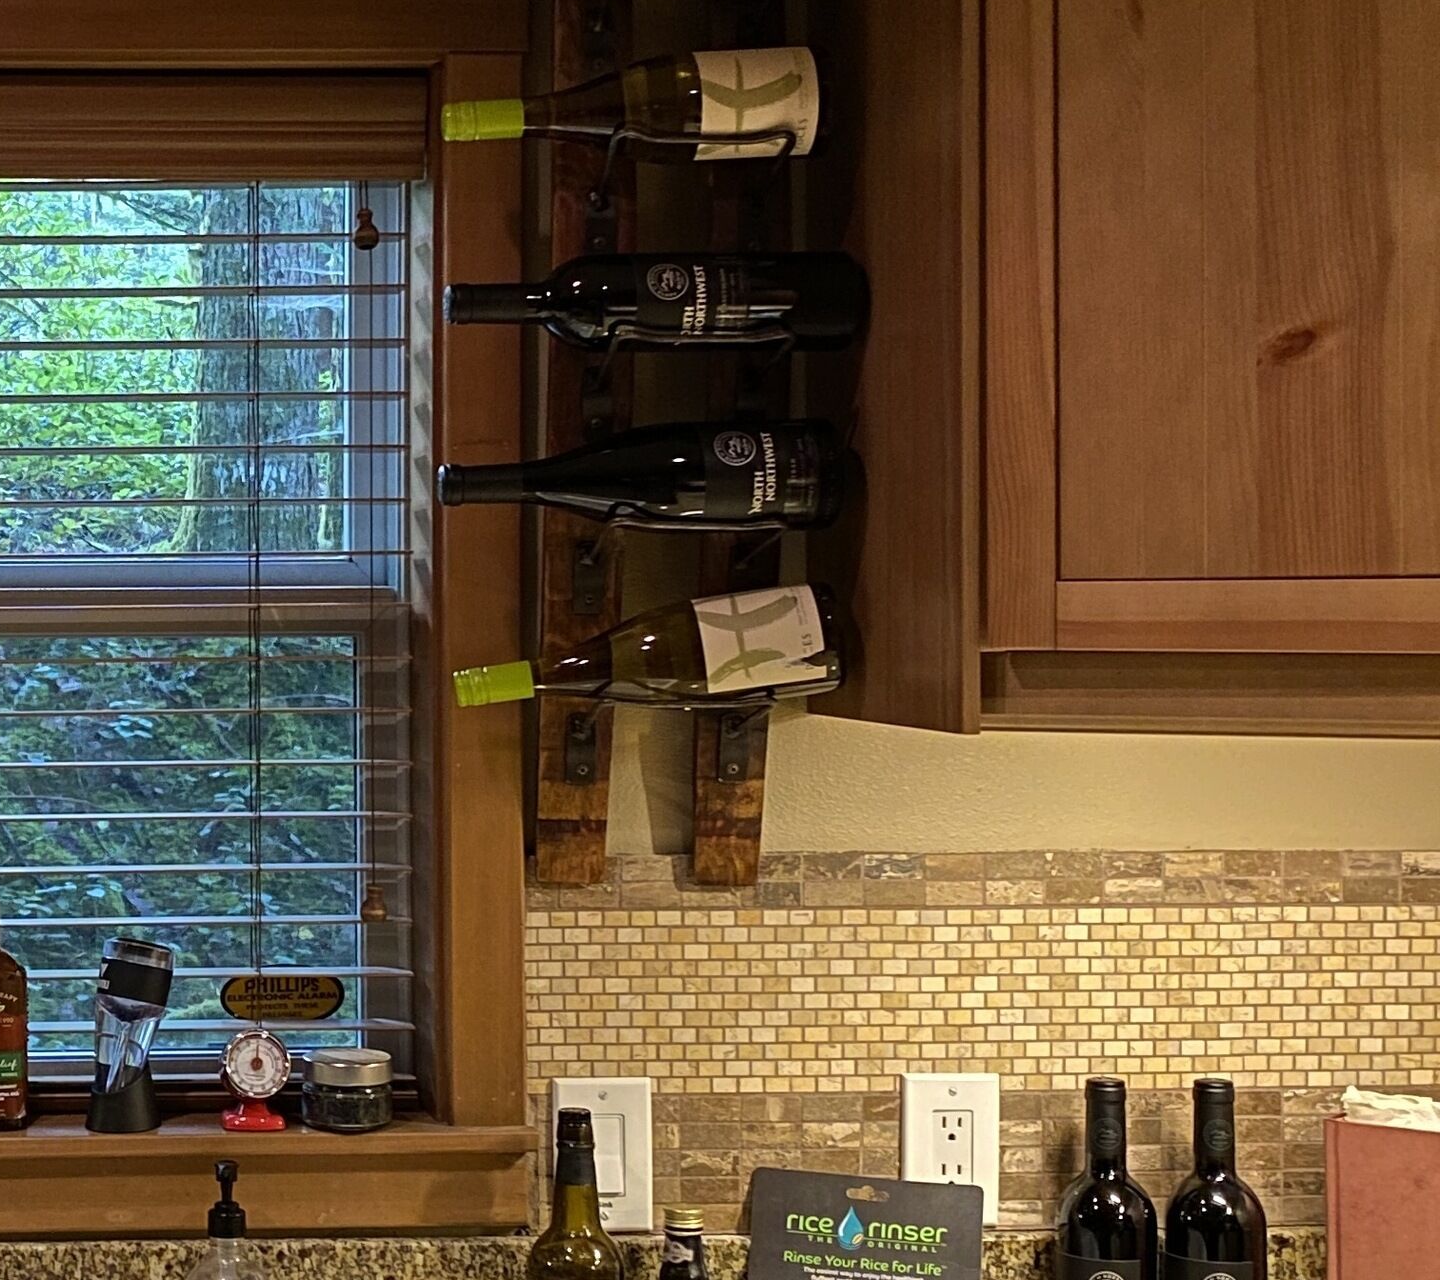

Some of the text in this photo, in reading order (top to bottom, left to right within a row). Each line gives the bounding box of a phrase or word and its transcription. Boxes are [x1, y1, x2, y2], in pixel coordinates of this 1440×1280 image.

[759, 431, 777, 502] NORTHWEST
[747, 470, 765, 516] NORTH
[245, 976, 320, 993] PHILLIPS
[297, 991, 338, 1001] ALARM
[786, 1214, 948, 1243] rice rinser
[807, 1234, 938, 1254] THE ORIGINAL
[783, 1250, 822, 1266] Rinse
[824, 1254, 858, 1269] Your
[860, 1258, 889, 1272] Rice
[892, 1260, 913, 1274] for
